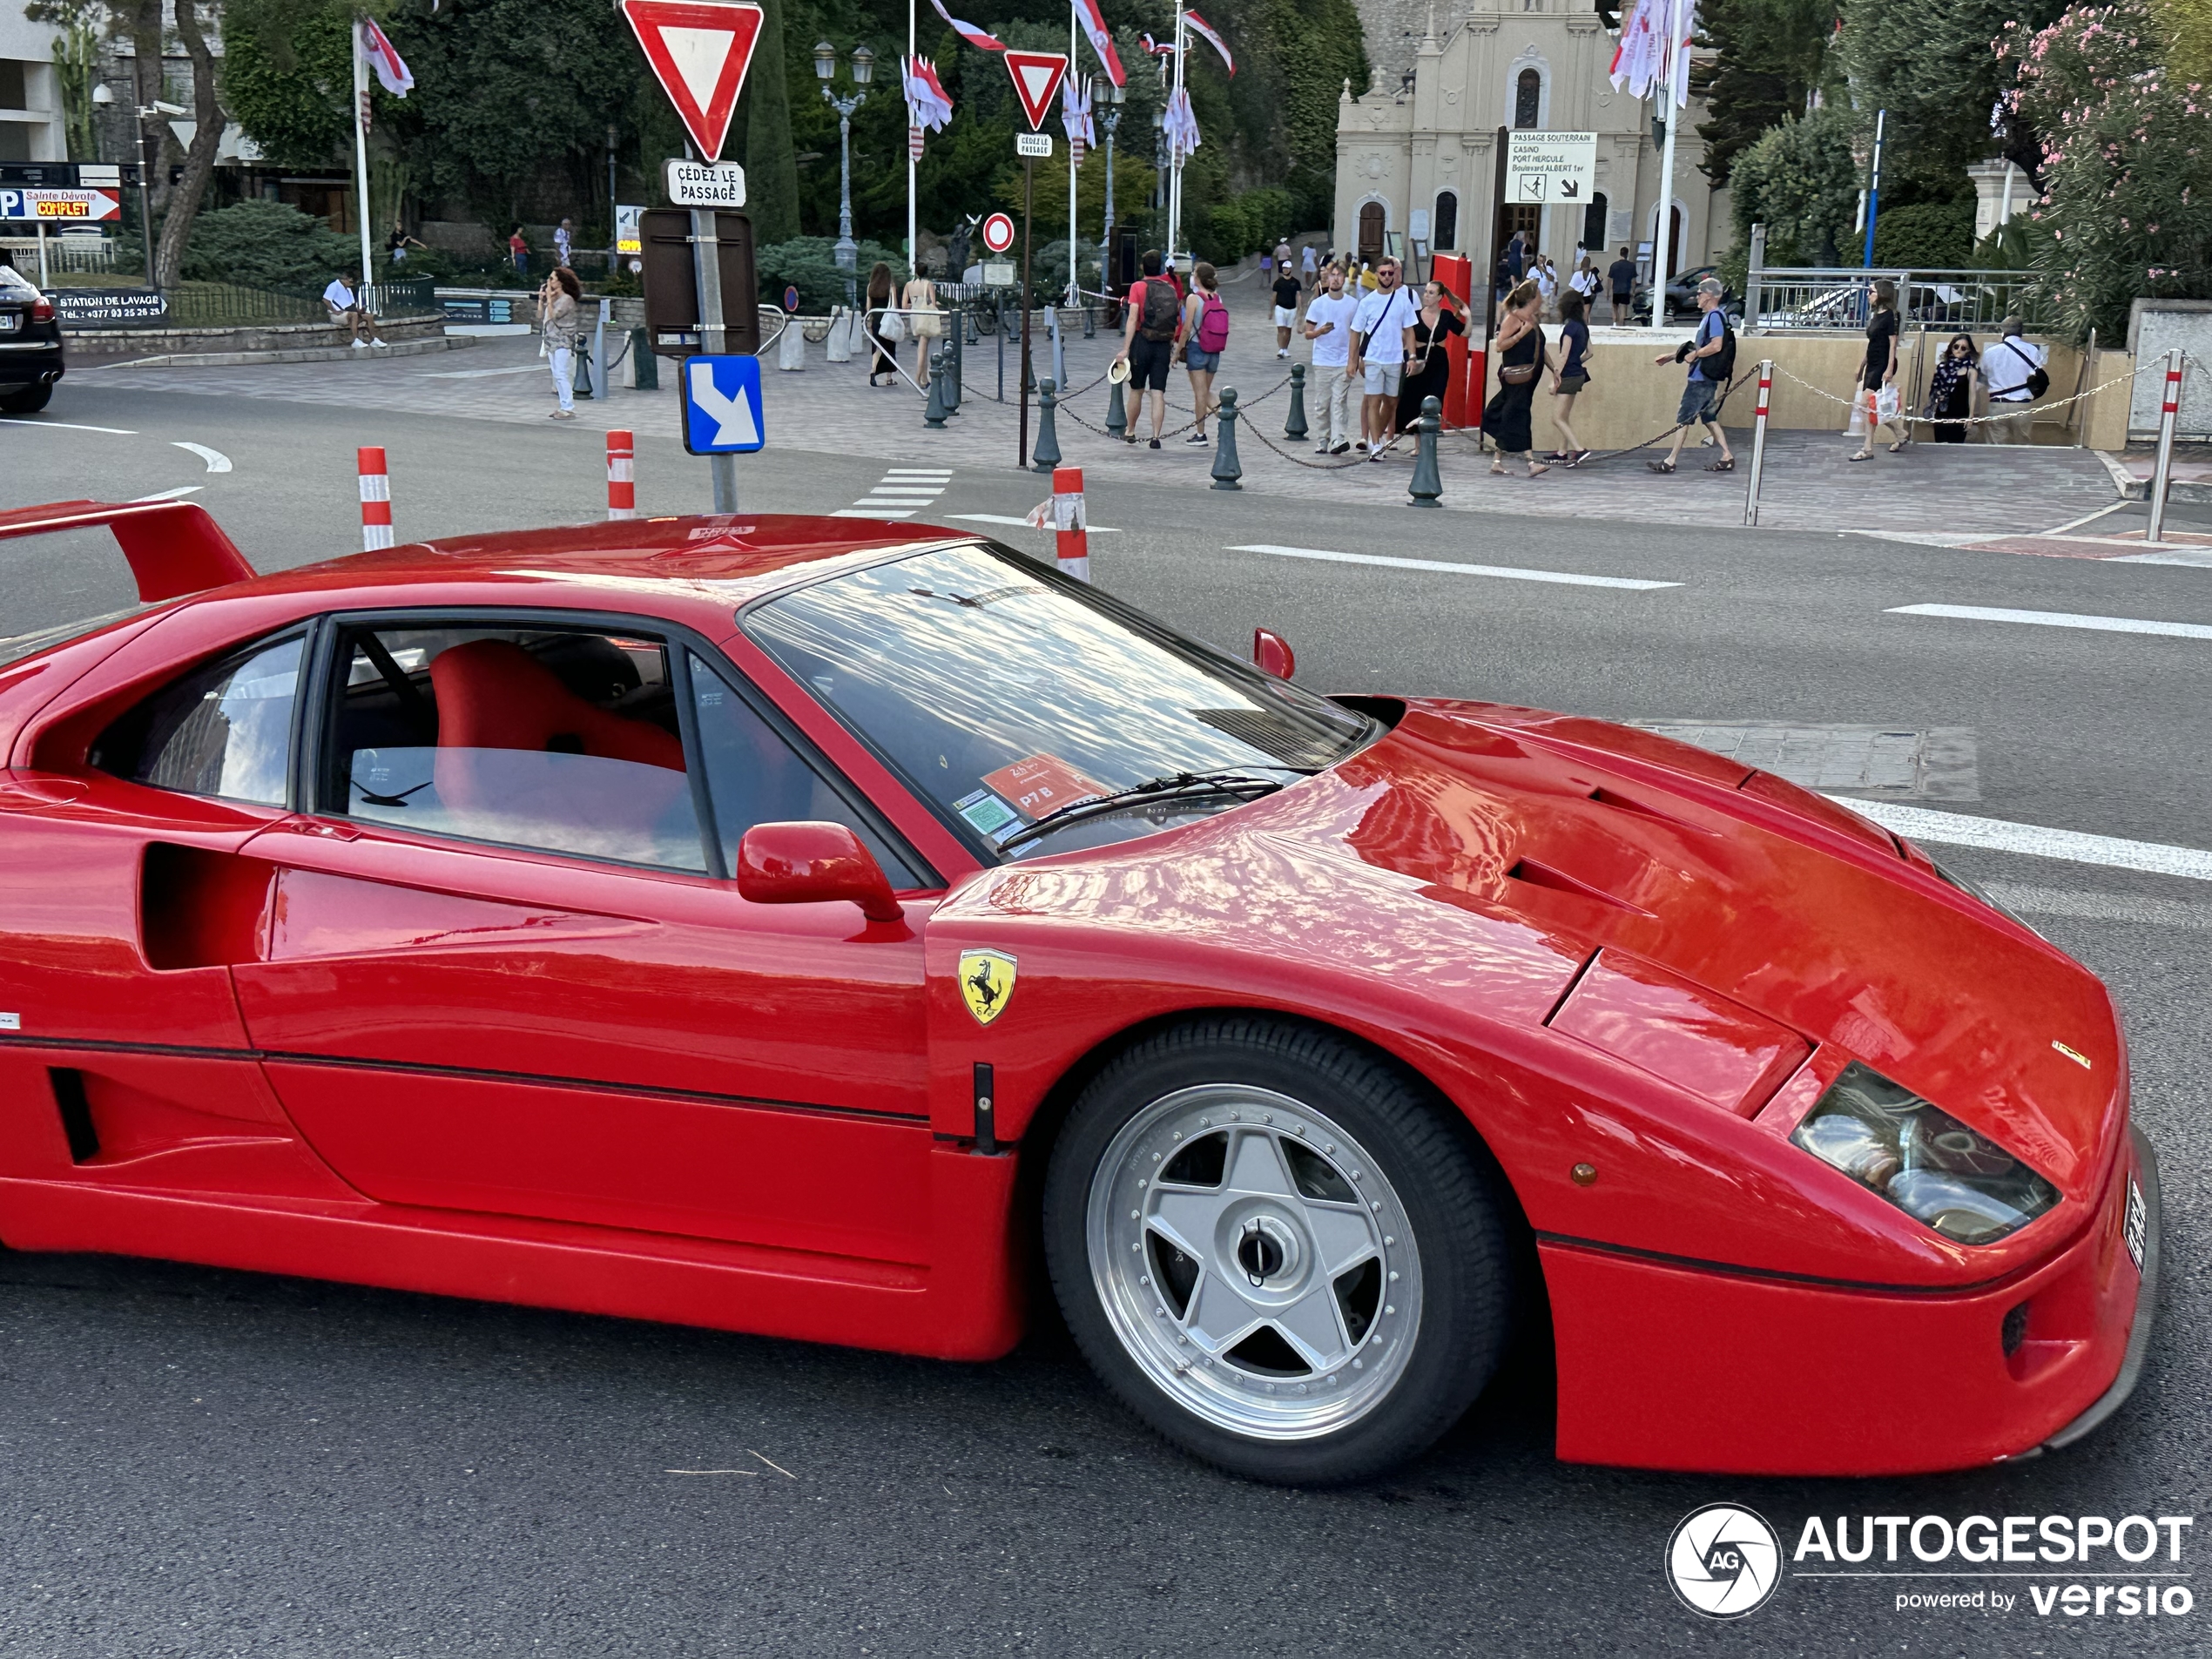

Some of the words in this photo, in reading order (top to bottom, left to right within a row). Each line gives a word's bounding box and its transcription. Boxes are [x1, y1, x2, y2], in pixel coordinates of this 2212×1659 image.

[678, 165, 717, 183] CÉDEZ
[722, 171, 737, 183] LE
[26, 191, 58, 200] Sainte
[61, 191, 97, 200] Dévote
[680, 185, 736, 200] PASSAGE
[37, 202, 89, 215] COMPLET
[60, 297, 103, 307] STATION
[105, 296, 119, 306] DE
[120, 295, 159, 305] LAVAGE
